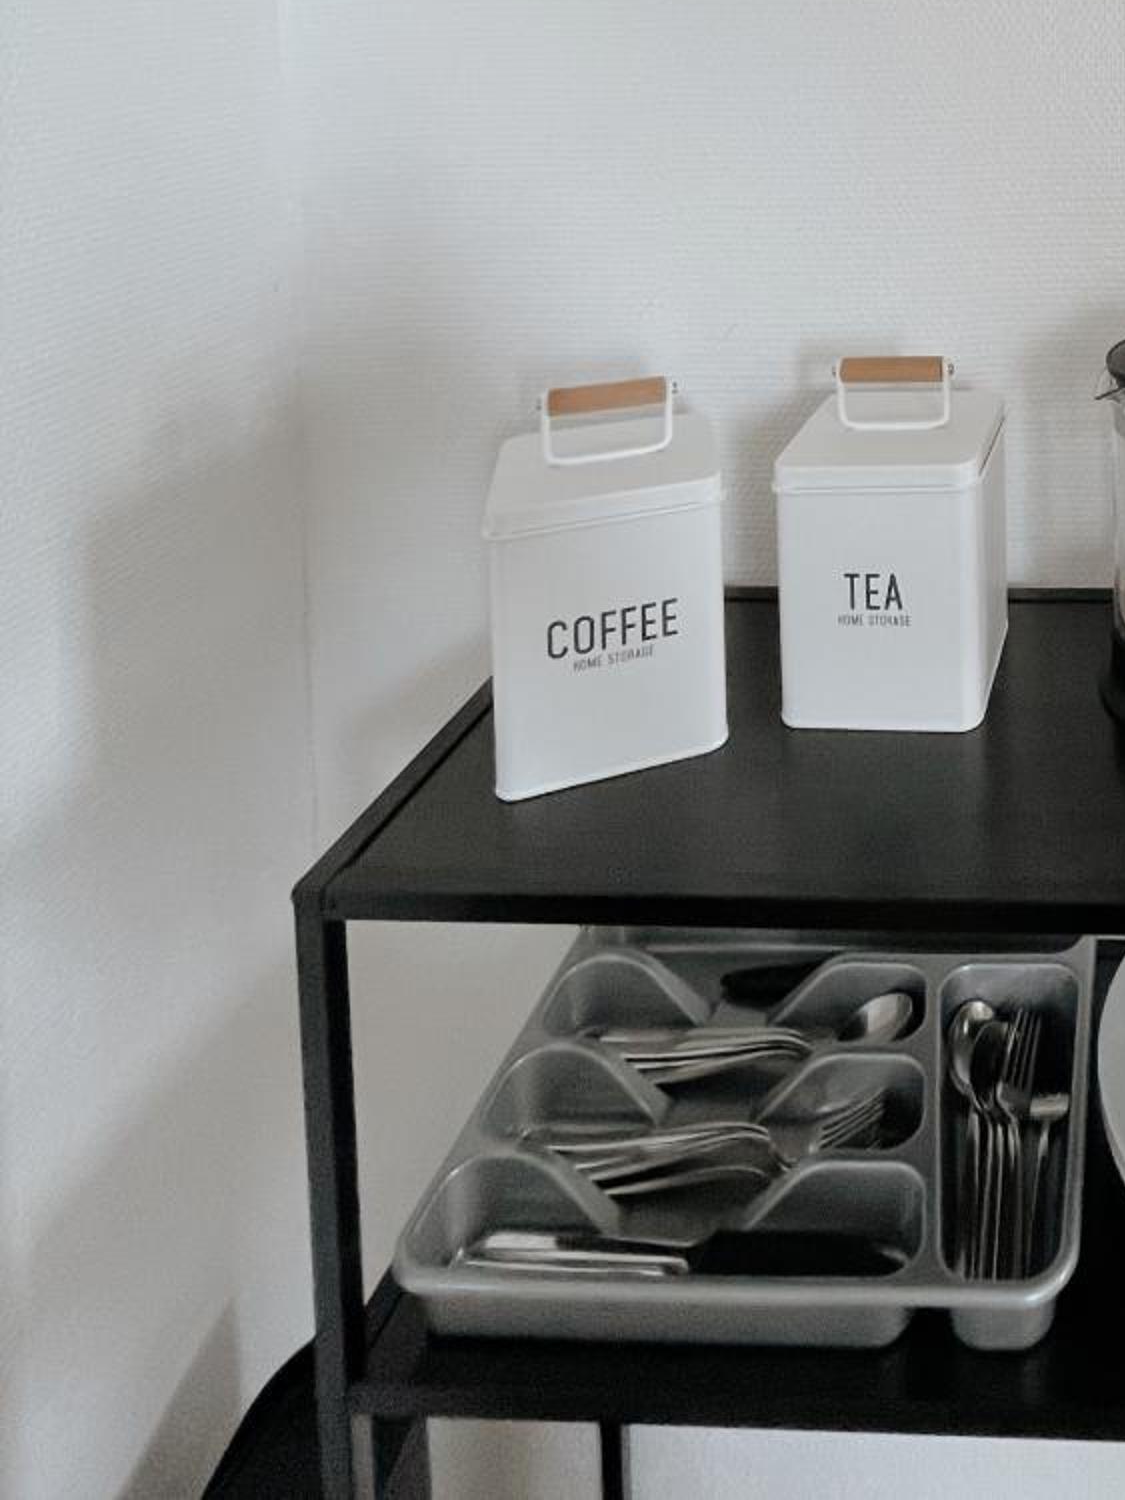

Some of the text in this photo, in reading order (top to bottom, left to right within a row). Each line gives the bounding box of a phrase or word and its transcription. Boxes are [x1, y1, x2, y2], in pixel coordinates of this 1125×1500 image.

[843, 572, 903, 611] TEA
[547, 597, 679, 660] COFFEE
[837, 614, 912, 627] HOME STORAGE
[572, 643, 654, 672] HOME STORAGE
